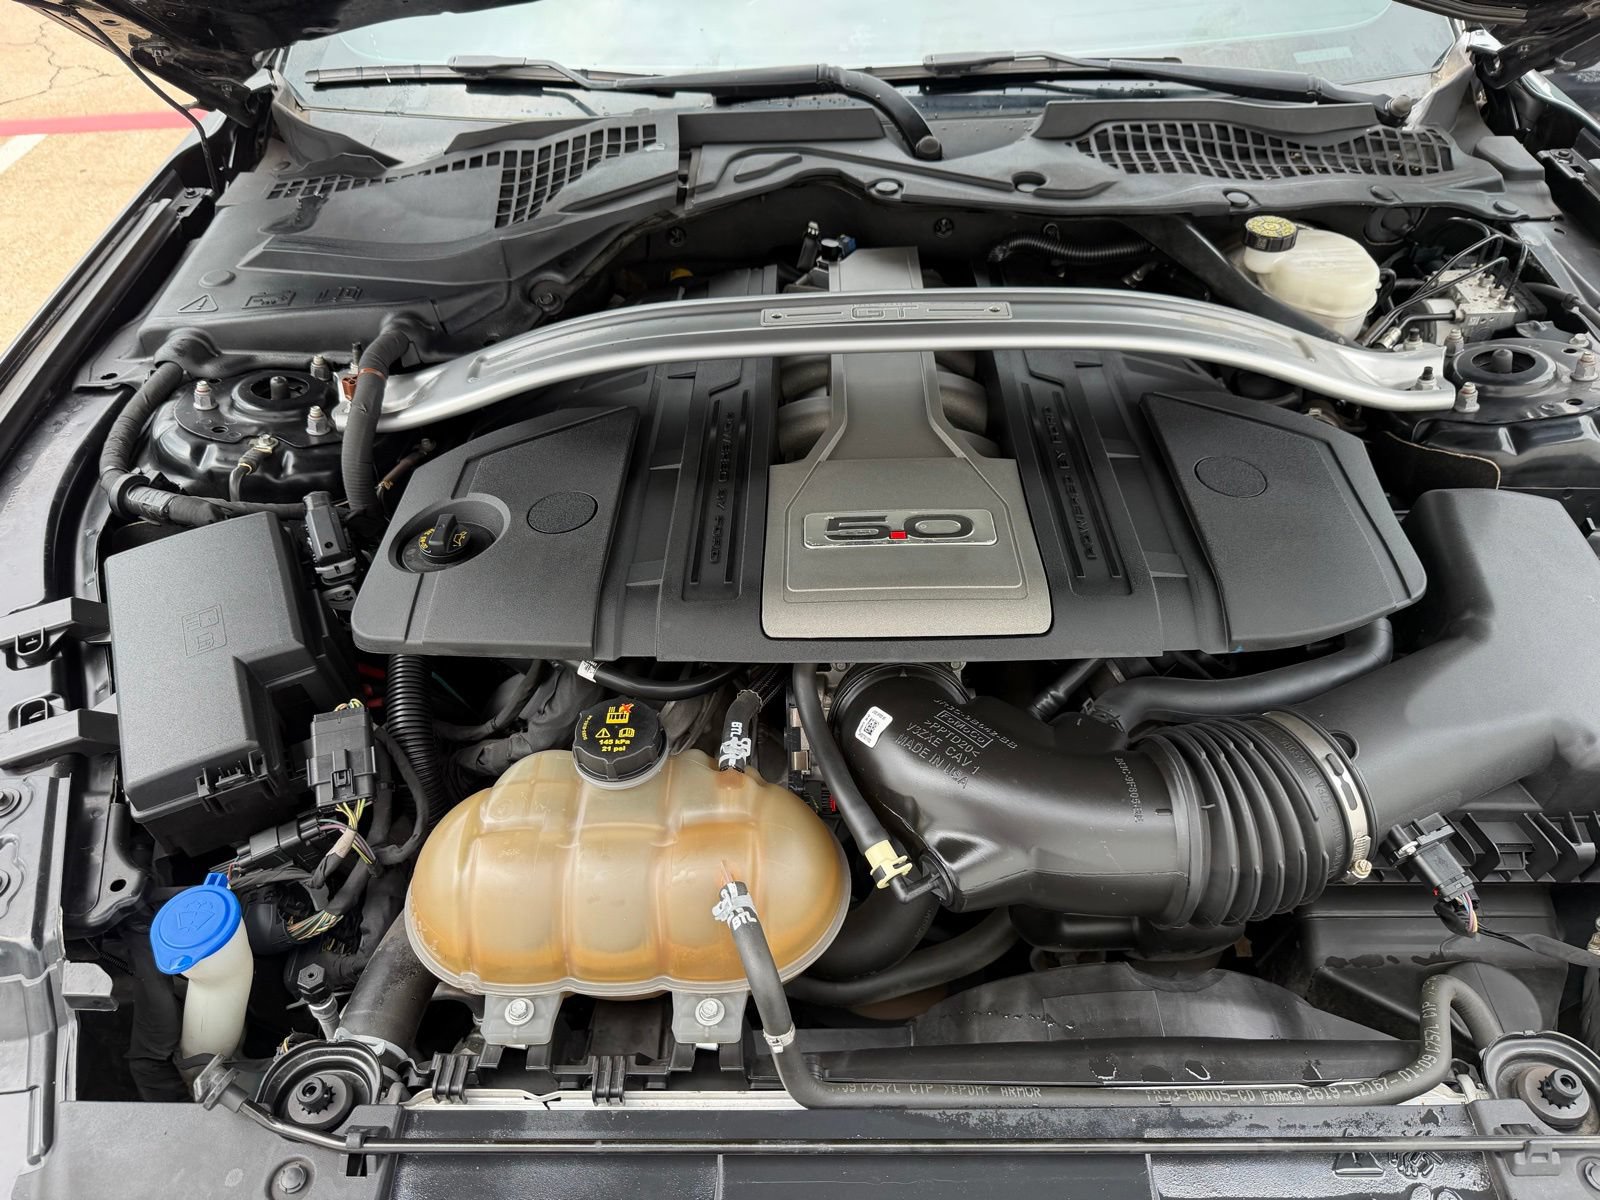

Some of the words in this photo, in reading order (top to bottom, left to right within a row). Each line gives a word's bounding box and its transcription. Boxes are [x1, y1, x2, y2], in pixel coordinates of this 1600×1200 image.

[851, 305, 919, 320] GT
[823, 514, 975, 541] 5.0
[939, 711, 986, 744] FoMoCo
[895, 733, 931, 760] MADE
[928, 754, 945, 768] IN
[943, 763, 970, 790] USA
[945, 746, 973, 767] CAV
[1000, 1086, 1043, 1098] ARMOR
[1263, 1090, 1303, 1101] FoMoCo
